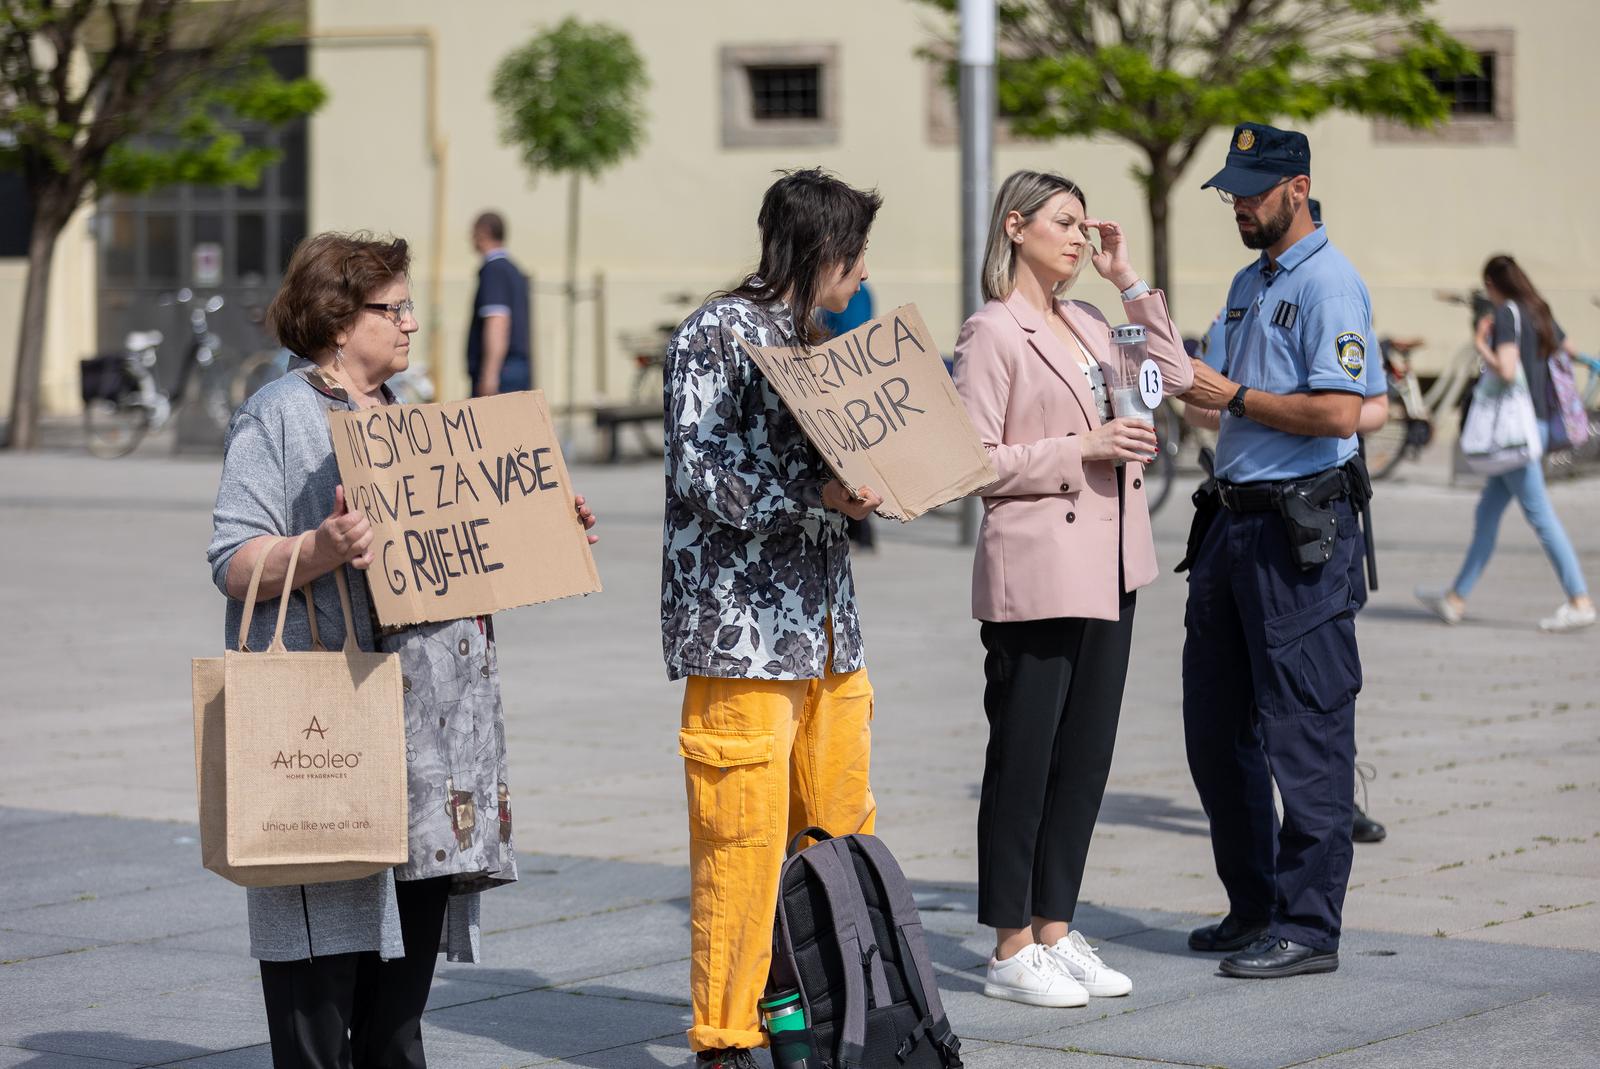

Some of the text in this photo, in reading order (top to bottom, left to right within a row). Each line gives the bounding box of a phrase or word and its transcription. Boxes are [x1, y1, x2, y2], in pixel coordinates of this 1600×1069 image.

[770, 315, 926, 400] MATERNICA
[1143, 369, 1159, 394] 13
[344, 405, 483, 470] NISMO MI
[797, 408, 843, 468] OJ
[430, 462, 480, 509] ZA
[478, 444, 559, 506] VAŠE
[262, 820, 371, 833] Unique like we all are.
